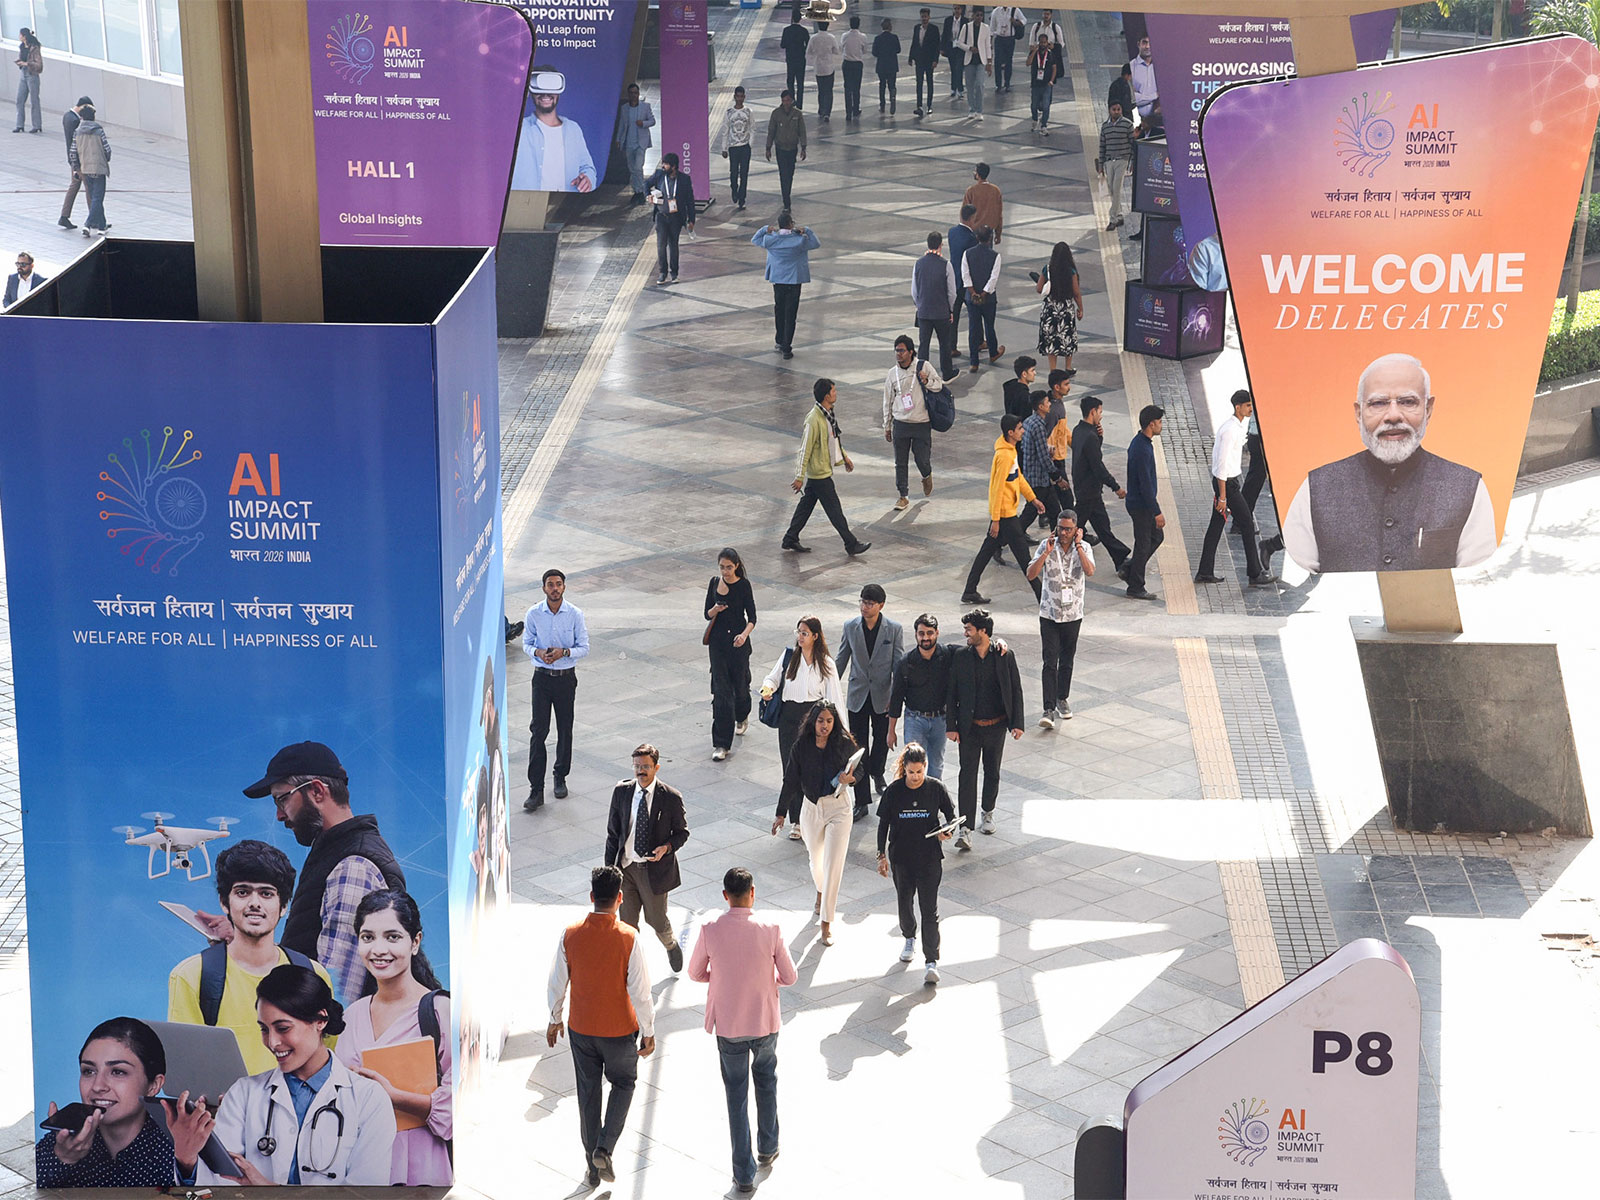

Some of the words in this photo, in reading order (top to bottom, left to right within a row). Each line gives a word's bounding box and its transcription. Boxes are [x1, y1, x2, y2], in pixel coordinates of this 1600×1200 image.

[521, 8, 615, 21] OPPORTUNITY
[384, 25, 408, 47] AI
[535, 25, 545, 33] AI
[548, 25, 571, 36] Leap
[574, 25, 596, 34] from
[551, 38, 561, 47] to
[564, 39, 596, 49] Impact
[384, 48, 422, 58] IMPACT
[384, 58, 425, 68] SUMMIT
[1192, 62, 1295, 76] SHOWCASING
[324, 92, 352, 104] सर्वजन
[385, 94, 412, 106] सर्वजन
[315, 110, 348, 118] WELFARE
[386, 112, 425, 120] HAPPINESS
[1408, 104, 1439, 128] AI
[1406, 131, 1455, 142] IMPACT
[1405, 143, 1457, 154] SUMMIT
[347, 160, 401, 178] HALL
[406, 161, 415, 179] 1
[1324, 189, 1358, 202] सर्वजन
[1363, 189, 1391, 202] हिताय
[1401, 188, 1436, 201] सर्वजन
[339, 212, 375, 224] Global
[378, 213, 423, 227] Insights
[1310, 210, 1351, 218] WELFARE
[1354, 210, 1371, 218] FOR
[1374, 210, 1390, 218] ALL
[1400, 209, 1450, 217] HAPPINESS
[1452, 209, 1464, 217] OF
[1466, 208, 1483, 216] ALL
[1261, 253, 1525, 294] WELCOME
[1274, 303, 1507, 330] DELEGATES
[228, 453, 281, 496] AI
[229, 500, 312, 519] IMPACT
[230, 521, 320, 540] SUMMIT
[230, 550, 260, 562] भारत
[263, 551, 284, 563] 2026
[287, 552, 311, 563] INDIA
[92, 594, 156, 618] सर्वजन
[163, 595, 215, 619] हिताय
[230, 596, 294, 620] सर्वजन
[299, 603, 354, 625] सुखाय
[73, 630, 146, 645] WELFARE
[151, 632, 184, 646] FOR
[187, 633, 215, 646] ALL
[233, 633, 320, 648] HAPPINESS
[325, 634, 345, 648] OF
[350, 634, 377, 648] ALL
[1312, 1030, 1394, 1076] P8
[1278, 1108, 1306, 1130] AI
[1277, 1132, 1321, 1142] IMPACT
[1277, 1142, 1325, 1152] SUMMIT
[1206, 1177, 1237, 1189] सर्वजन
[1242, 1178, 1266, 1190] हिताय
[1275, 1179, 1307, 1191] सर्वजन
